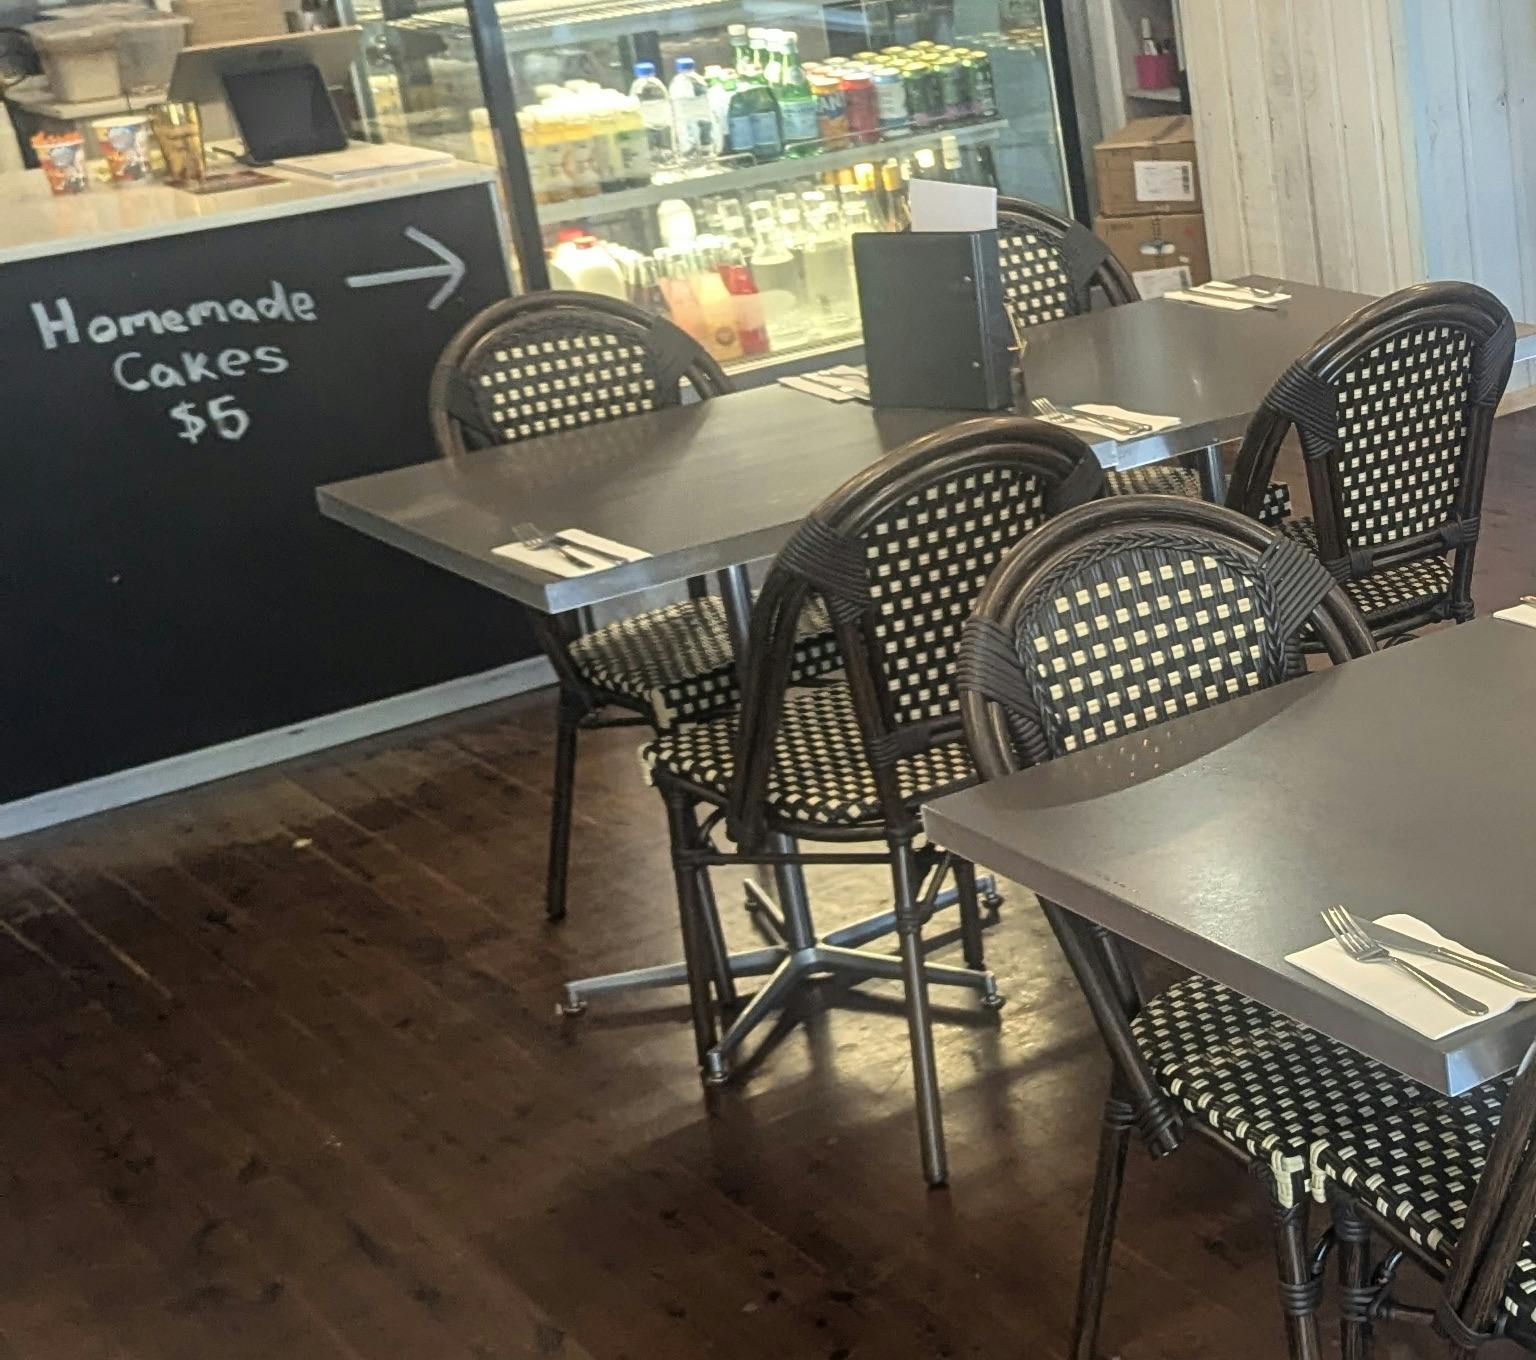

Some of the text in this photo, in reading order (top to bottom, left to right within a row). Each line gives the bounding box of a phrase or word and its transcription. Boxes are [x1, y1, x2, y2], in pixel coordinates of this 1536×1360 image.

[30, 280, 318, 349] Homemade
[113, 345, 289, 392] Cakes
[169, 394, 251, 444] $5
